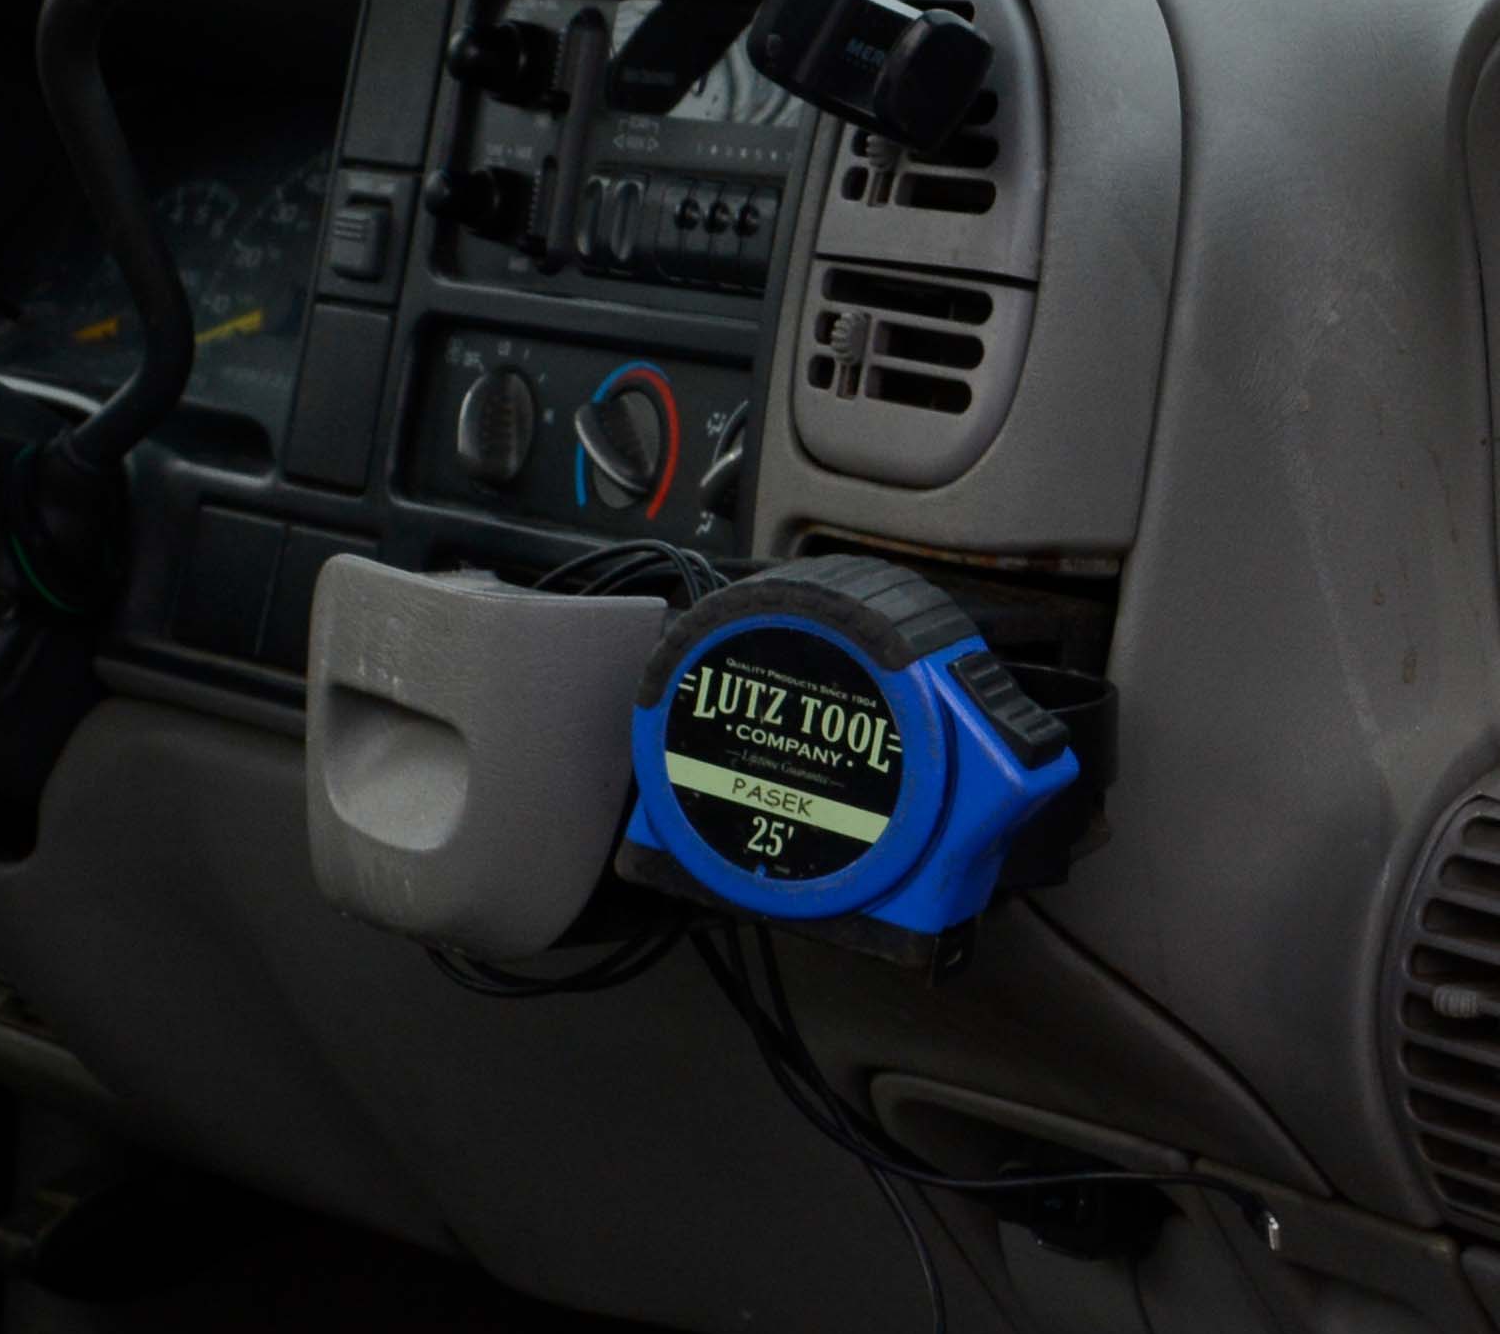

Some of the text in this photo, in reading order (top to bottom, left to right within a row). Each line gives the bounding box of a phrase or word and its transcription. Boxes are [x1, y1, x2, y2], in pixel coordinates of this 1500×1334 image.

[692, 665, 892, 774] LUTZ TOOL
[734, 723, 845, 769] COMPANY
[731, 777, 814, 819] PASEK
[746, 815, 795, 858] 25'
